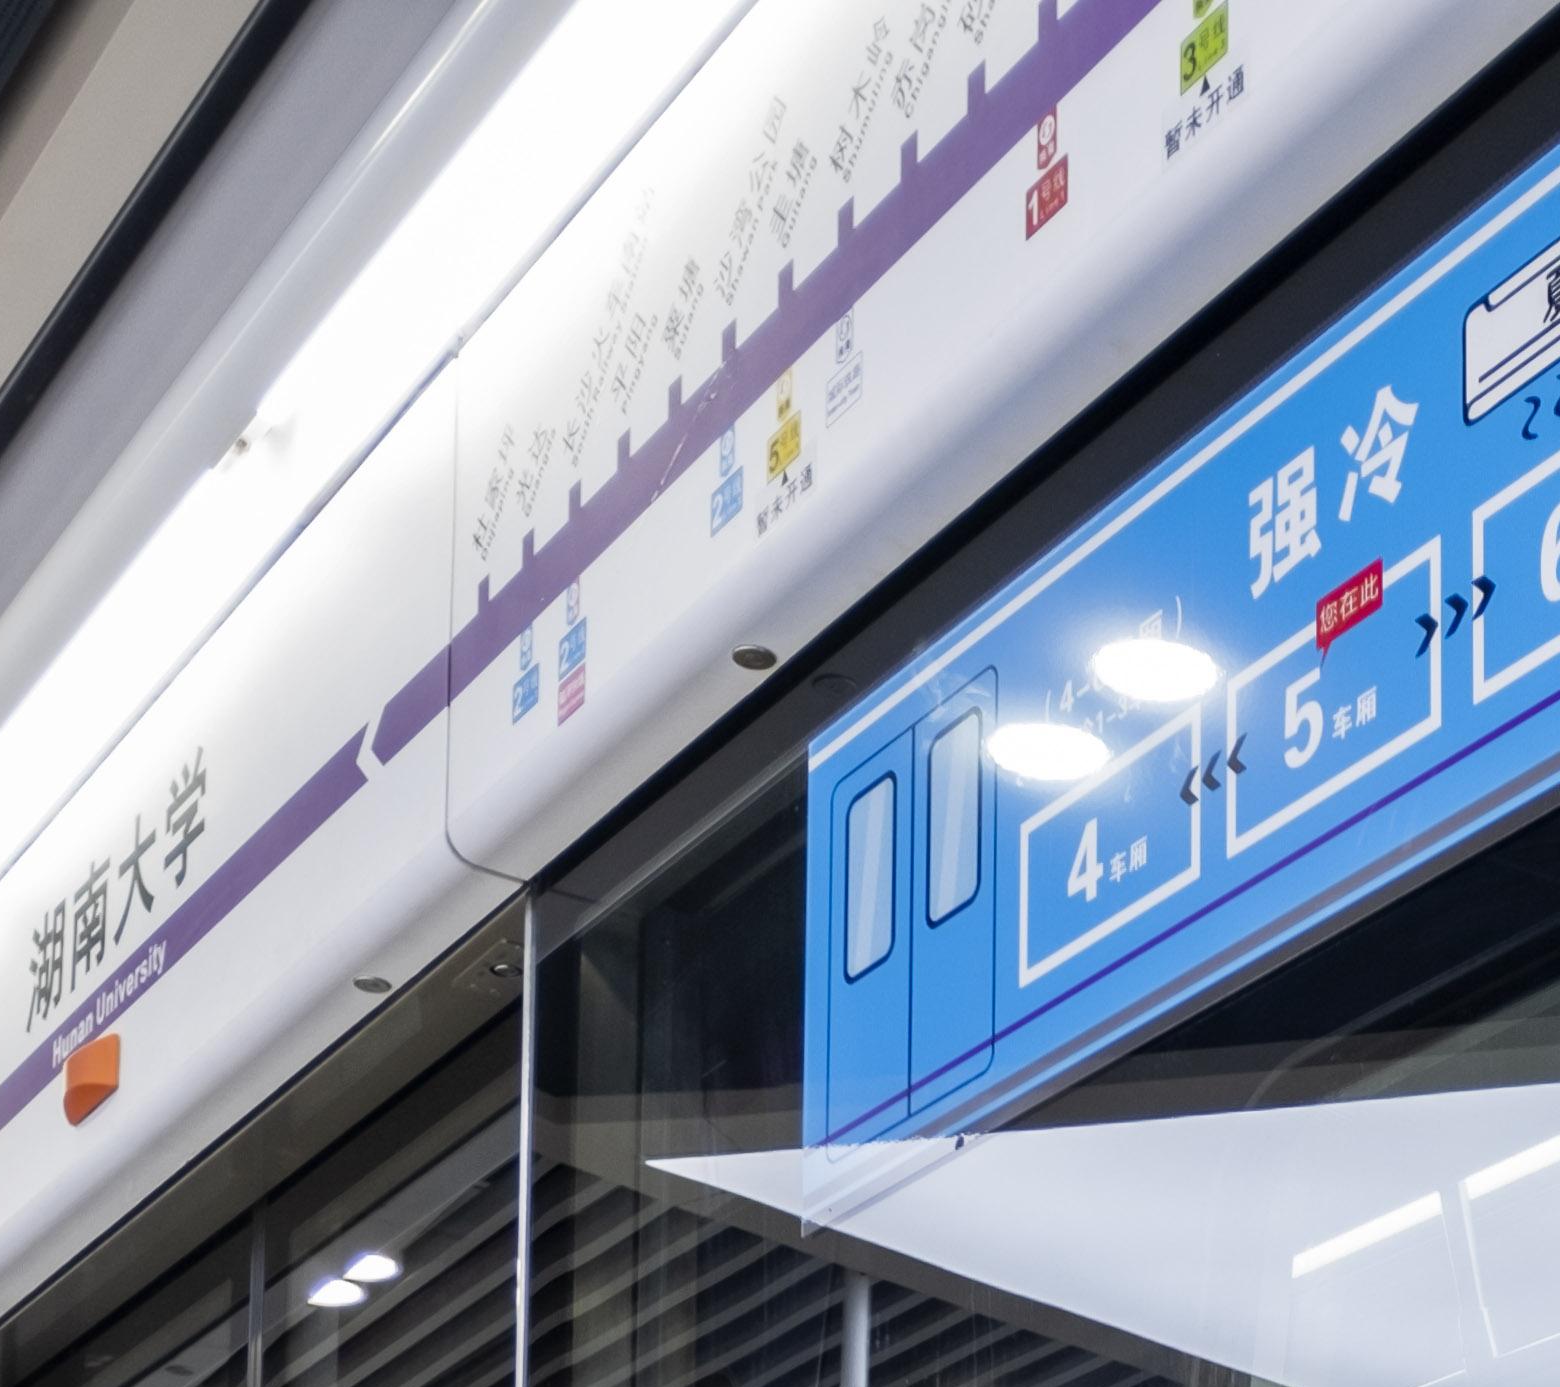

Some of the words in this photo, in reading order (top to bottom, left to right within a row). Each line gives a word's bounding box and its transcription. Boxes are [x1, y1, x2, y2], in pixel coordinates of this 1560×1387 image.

[1165, 64, 1244, 160] 暂未开通
[1246, 384, 1420, 598] 强冷
[1318, 572, 1383, 641] 您在此
[1283, 668, 1379, 769] 5车厢
[26, 746, 208, 1034] 湖南大学
[1067, 816, 1148, 903] 4车厢
[50, 1004, 96, 1070] Hunan
[94, 937, 168, 1029] University
